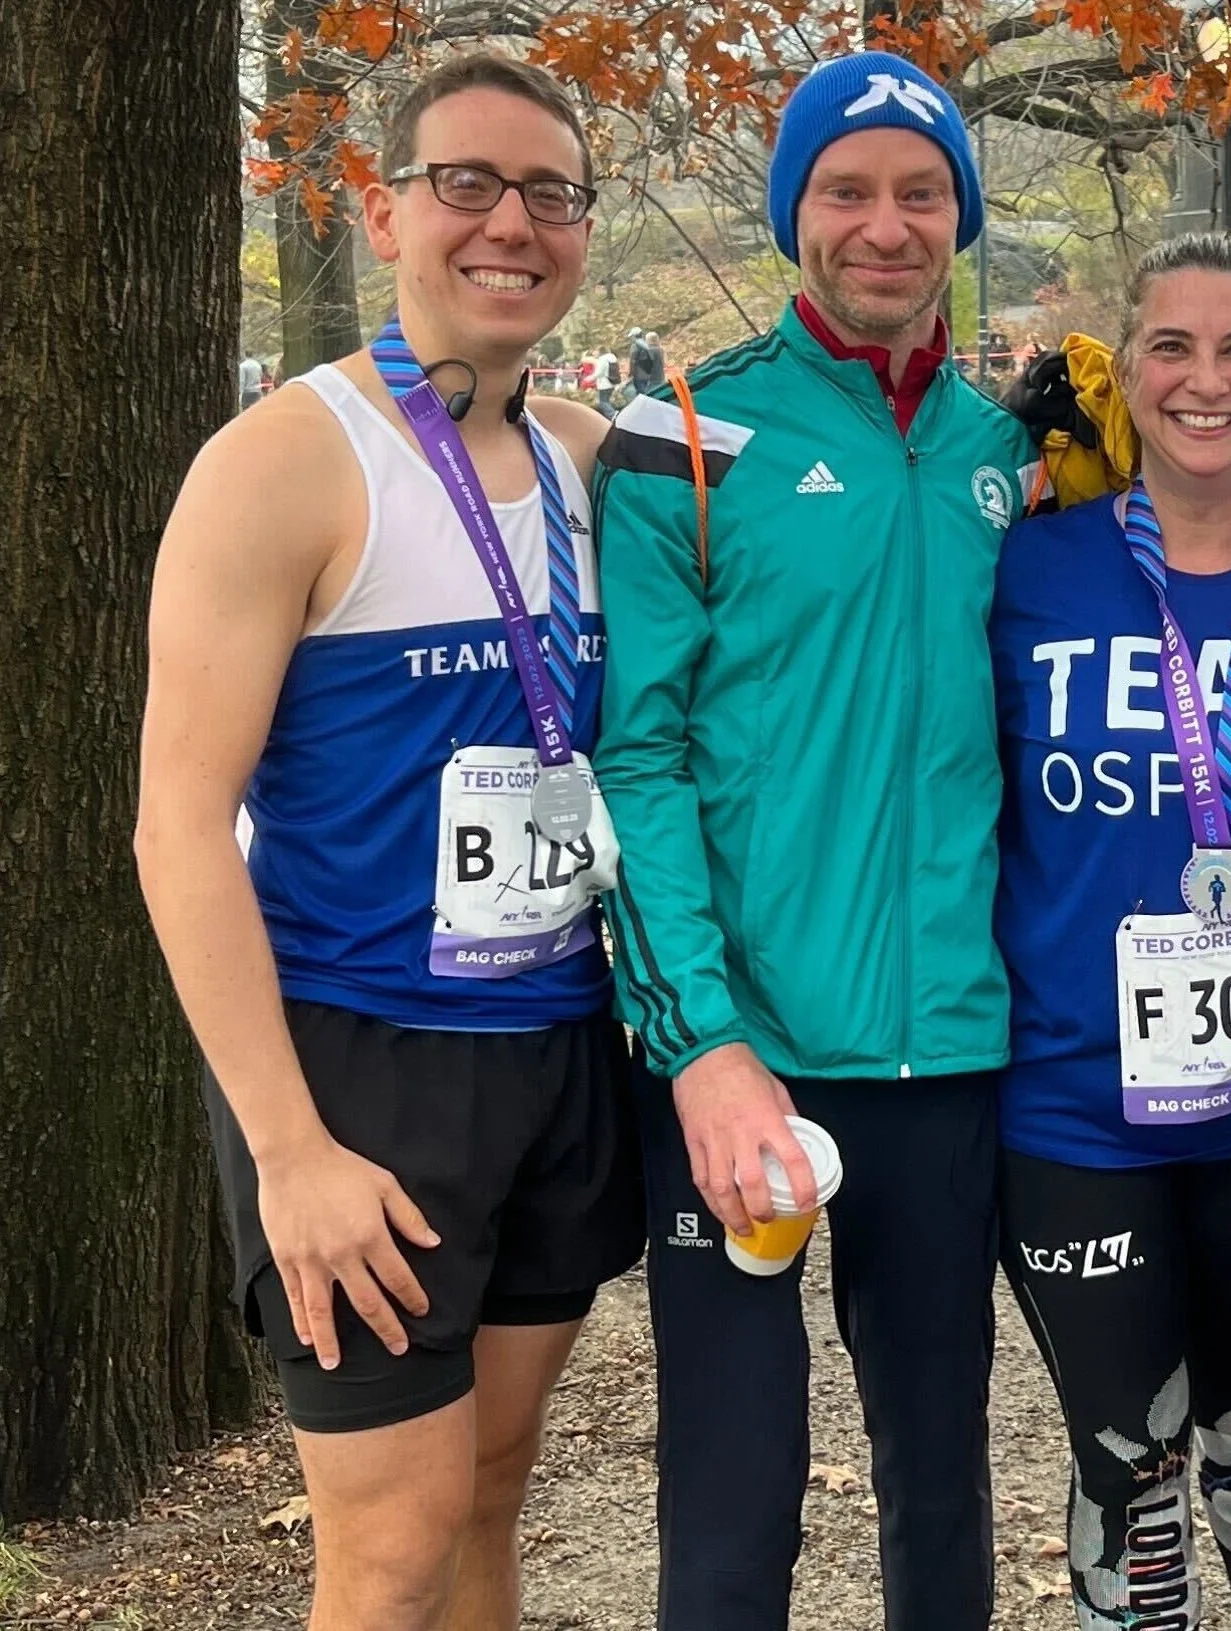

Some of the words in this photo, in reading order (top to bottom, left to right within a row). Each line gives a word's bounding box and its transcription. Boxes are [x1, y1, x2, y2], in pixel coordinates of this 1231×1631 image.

[461, 484, 477, 512] ROAD
[796, 481, 844, 493] adidas
[404, 640, 510, 677] TEAM
[540, 715, 564, 759] 15K
[1168, 655, 1203, 746] CORBITT
[1189, 752, 1212, 796] 15K
[460, 771, 502, 789] TED
[456, 826, 494, 882] B
[456, 951, 489, 964] BAG
[493, 948, 537, 964] CHECK
[1132, 937, 1174, 954] TED
[1135, 988, 1163, 1039] F
[1147, 1100, 1178, 1113] BAG
[1182, 1093, 1230, 1112] CHECK
[667, 1236, 712, 1248] salomon
[1020, 1241, 1073, 1274] tcs
